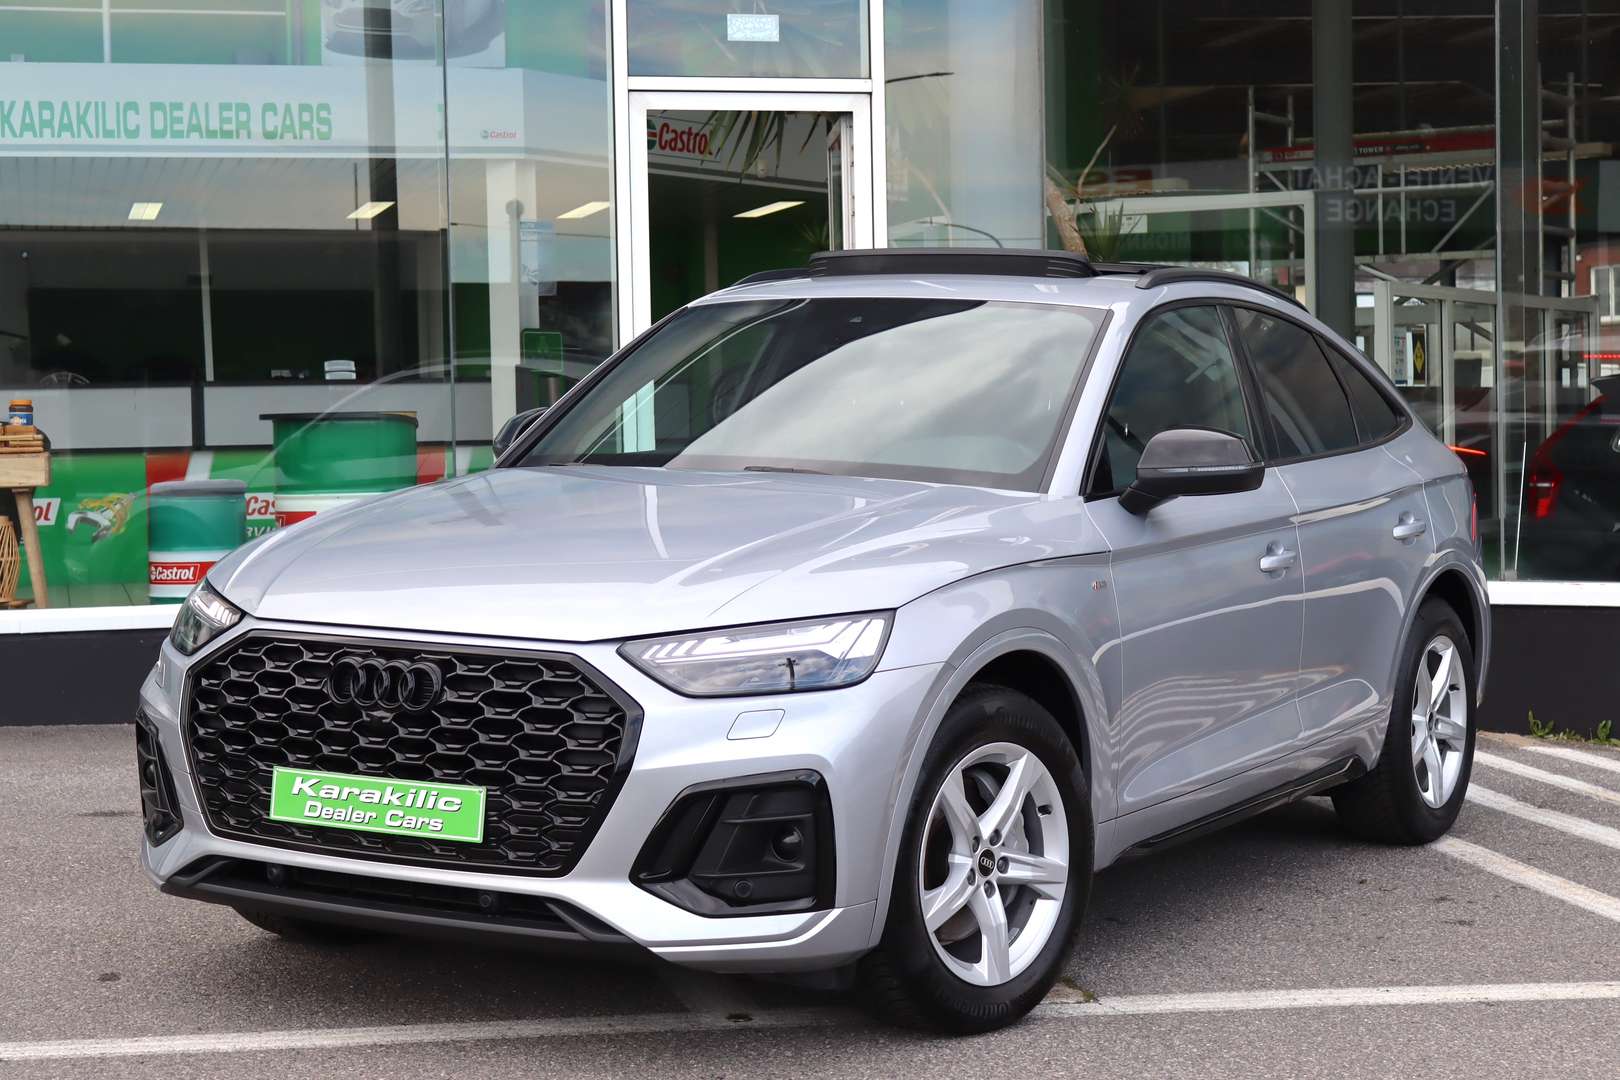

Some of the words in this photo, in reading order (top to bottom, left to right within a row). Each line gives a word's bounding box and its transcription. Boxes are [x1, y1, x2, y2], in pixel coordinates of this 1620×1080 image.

[0, 100, 140, 139] KARAKILIC
[150, 101, 251, 140] DEALER
[261, 102, 332, 141] CARS
[156, 566, 195, 580] Castrol
[291, 777, 463, 812] Karakilic
[303, 800, 377, 825] Dealer
[384, 809, 444, 832] Cars
